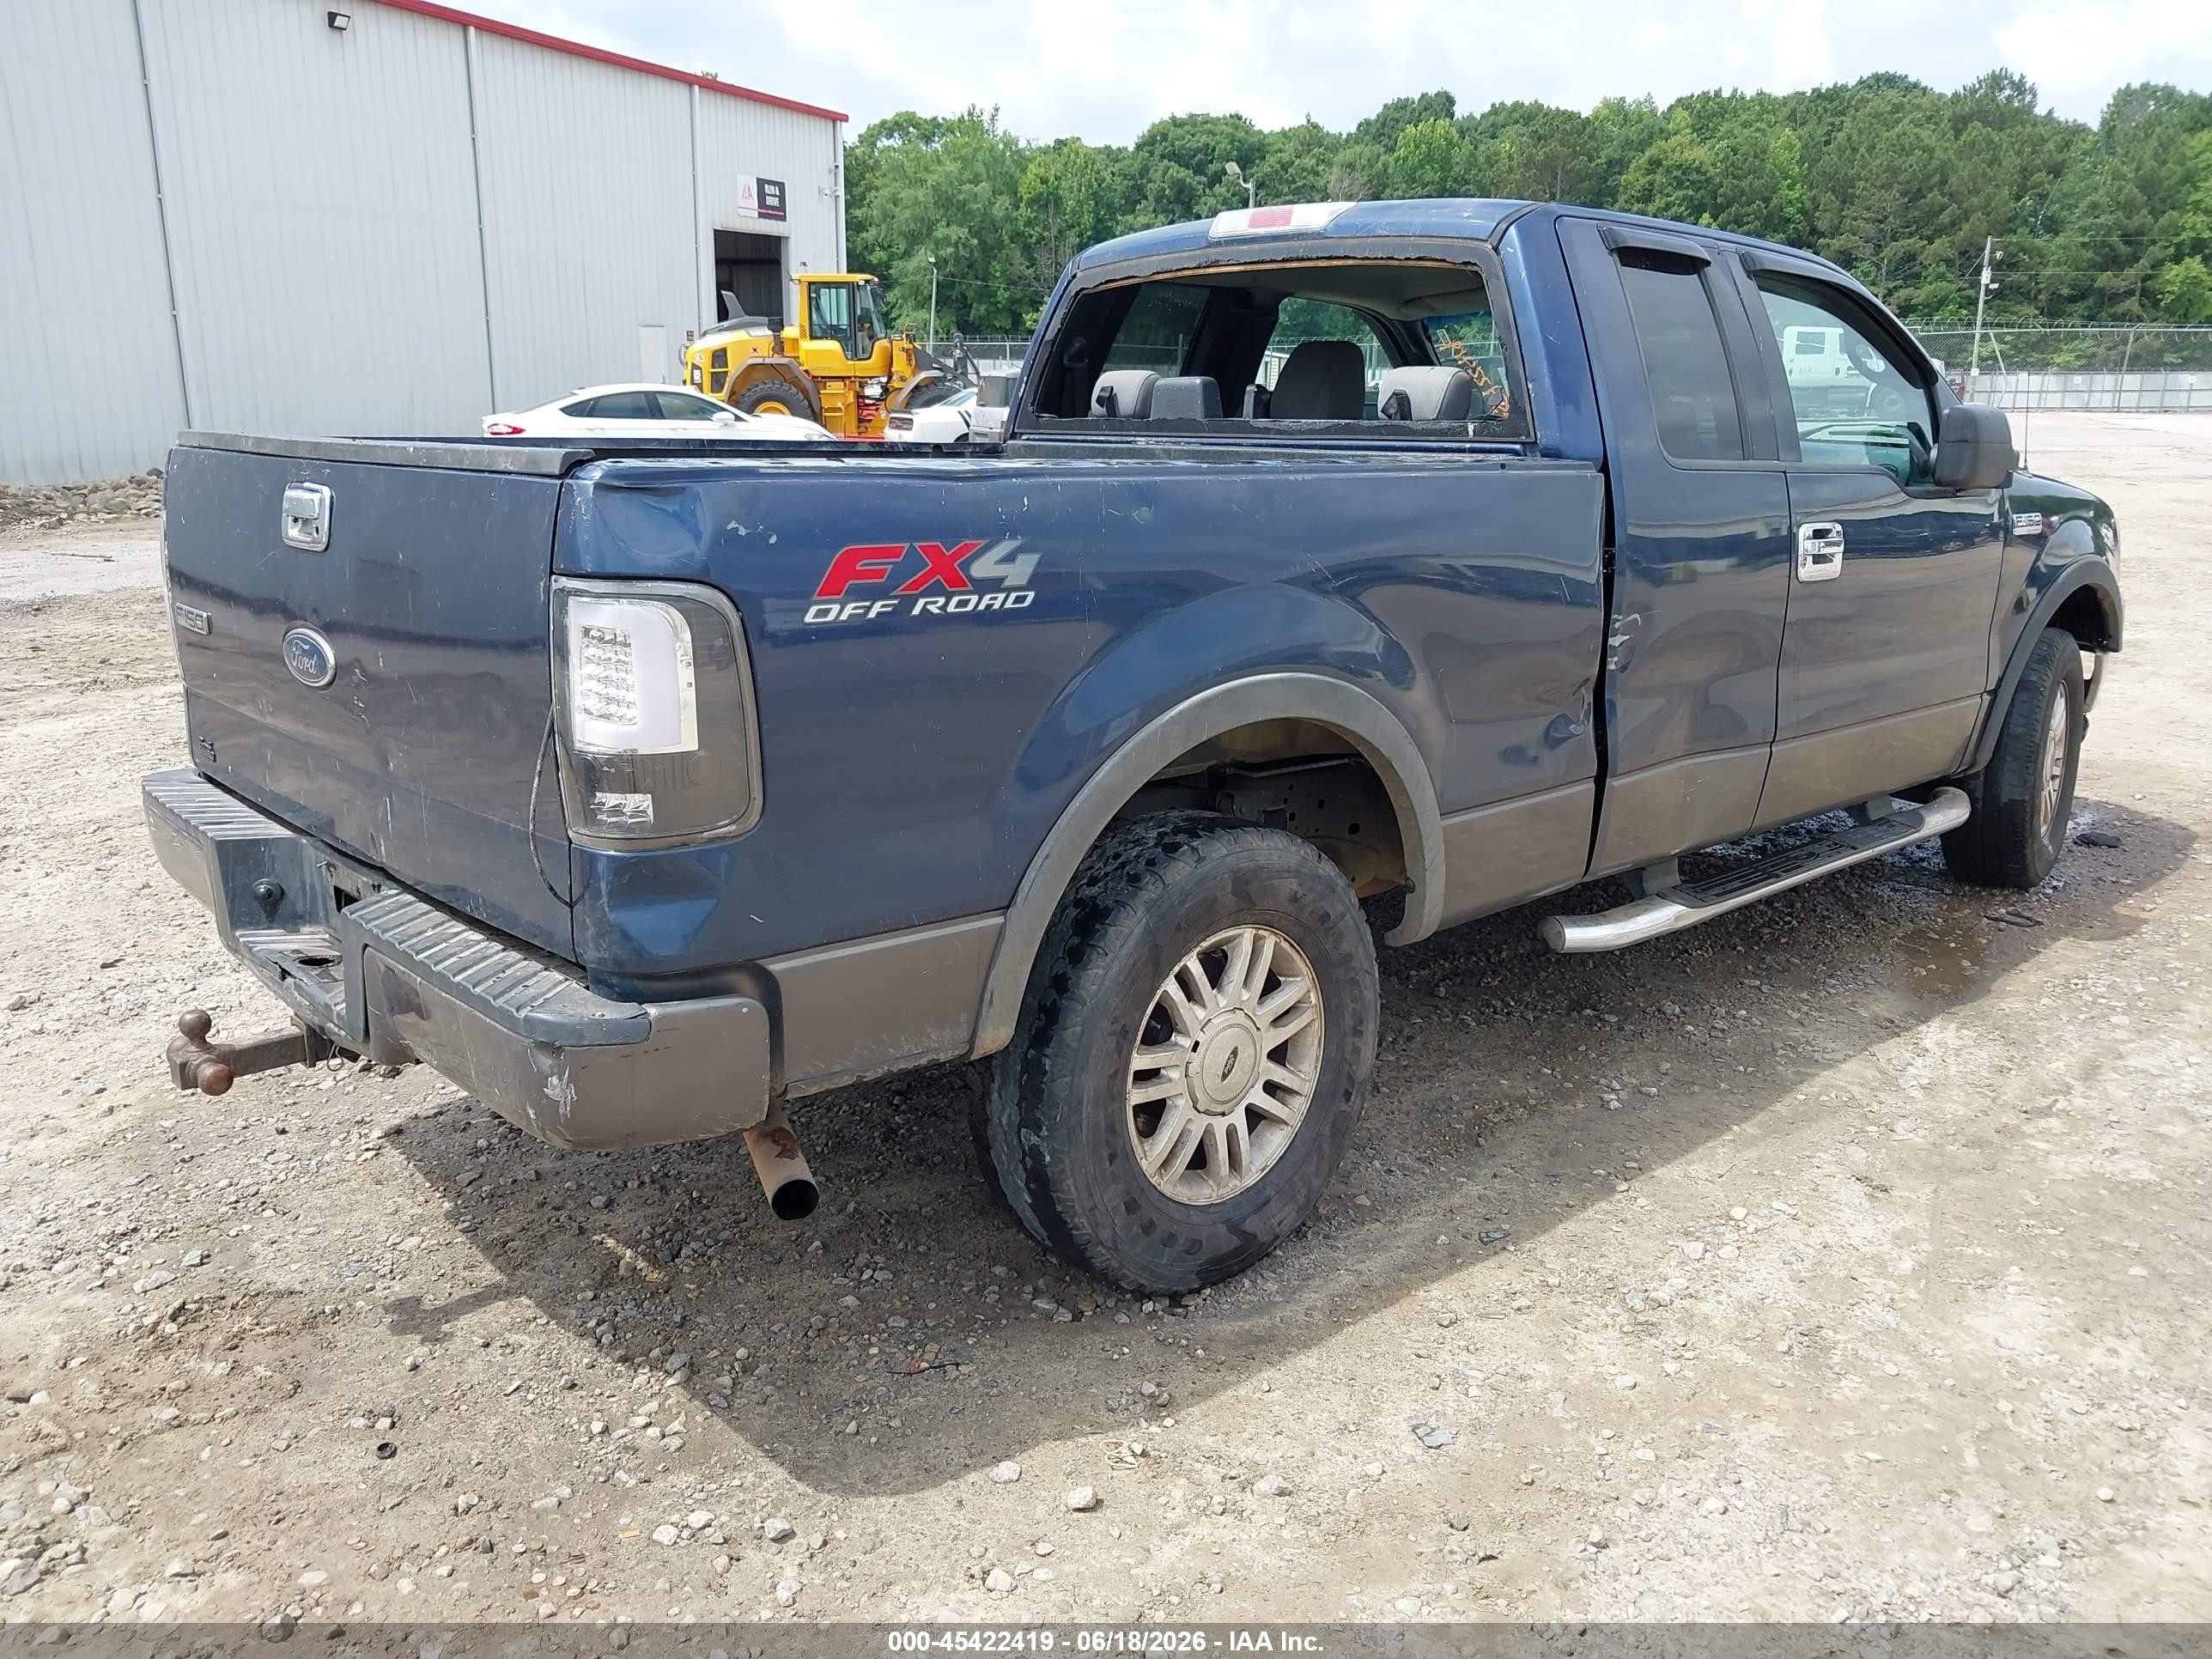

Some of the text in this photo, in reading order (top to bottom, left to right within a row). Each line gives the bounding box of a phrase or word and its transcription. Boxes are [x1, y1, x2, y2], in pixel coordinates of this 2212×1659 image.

[811, 538, 1044, 600] FX4
[802, 590, 1037, 625] OFF ROAD
[289, 639, 318, 674] Ford
